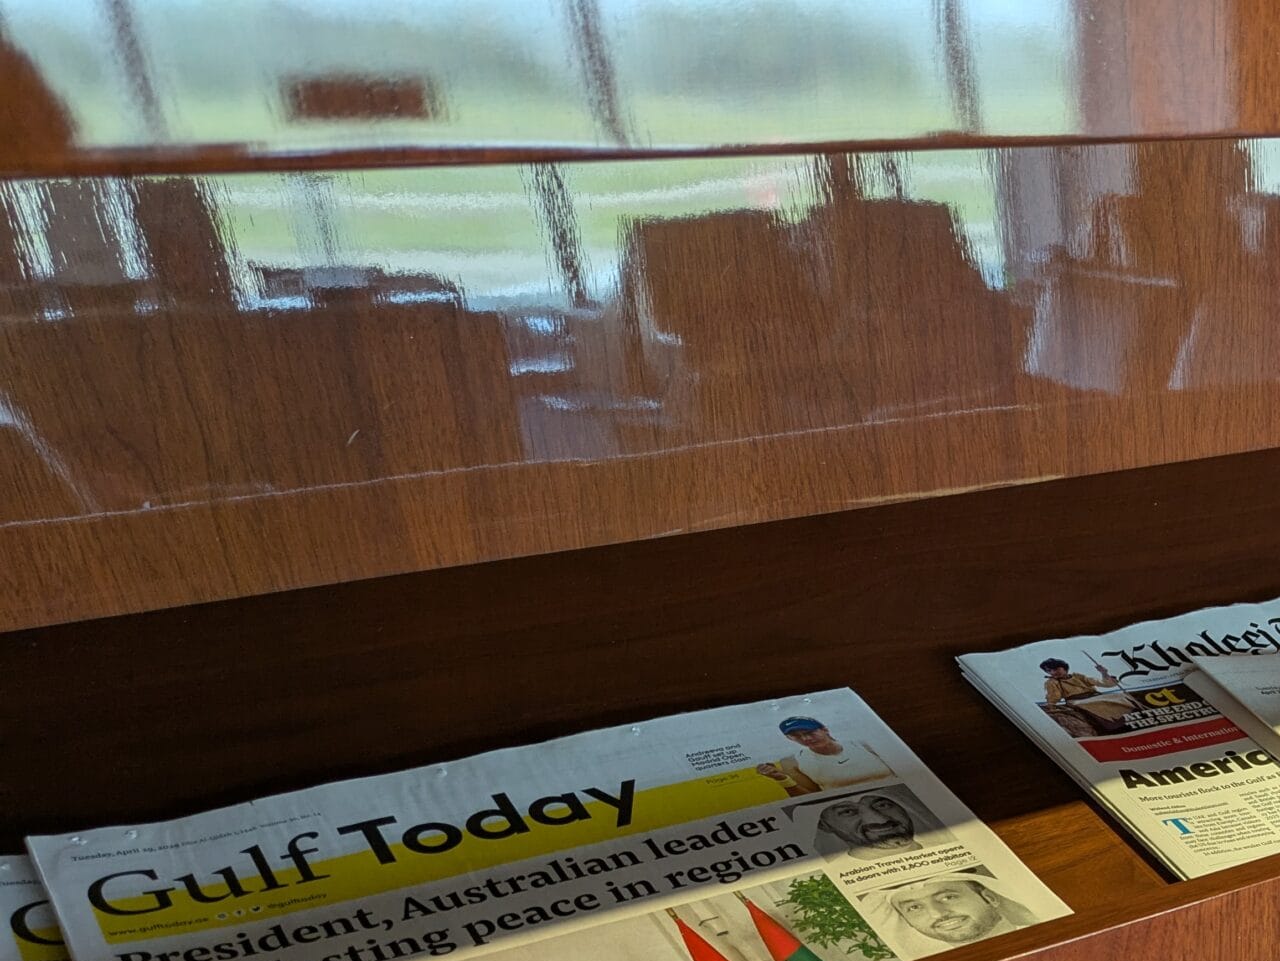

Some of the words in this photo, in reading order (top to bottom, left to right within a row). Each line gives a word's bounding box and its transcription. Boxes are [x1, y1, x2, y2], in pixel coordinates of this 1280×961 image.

[1123, 711, 1144, 723] AT
[1145, 706, 1173, 719] THE
[1174, 701, 1203, 715] END
[1125, 716, 1158, 729] THE
[1121, 738, 1171, 753] Domestic
[1173, 736, 1183, 745] &
[1138, 795, 1163, 803] More
[1163, 790, 1199, 801] tourists
[1199, 785, 1222, 795] flock
[1231, 780, 1244, 789] the
[1245, 775, 1265, 785] Gulf
[1266, 773, 1277, 781] as
[87, 832, 330, 916] Gulf
[337, 779, 635, 865] Today
[839, 864, 876, 879] Arabian
[875, 857, 904, 870] Travel
[904, 850, 937, 863] Market
[937, 845, 965, 857] opens
[944, 857, 967, 868] Page
[401, 851, 644, 921] Australian
[642, 816, 780, 860] leader
[844, 876, 855, 885] its
[856, 871, 881, 882] doors
[881, 865, 901, 878] with
[930, 850, 972, 866] exhibitors
[461, 893, 608, 947] peace
[606, 880, 661, 903] in
[664, 844, 808, 890] region
